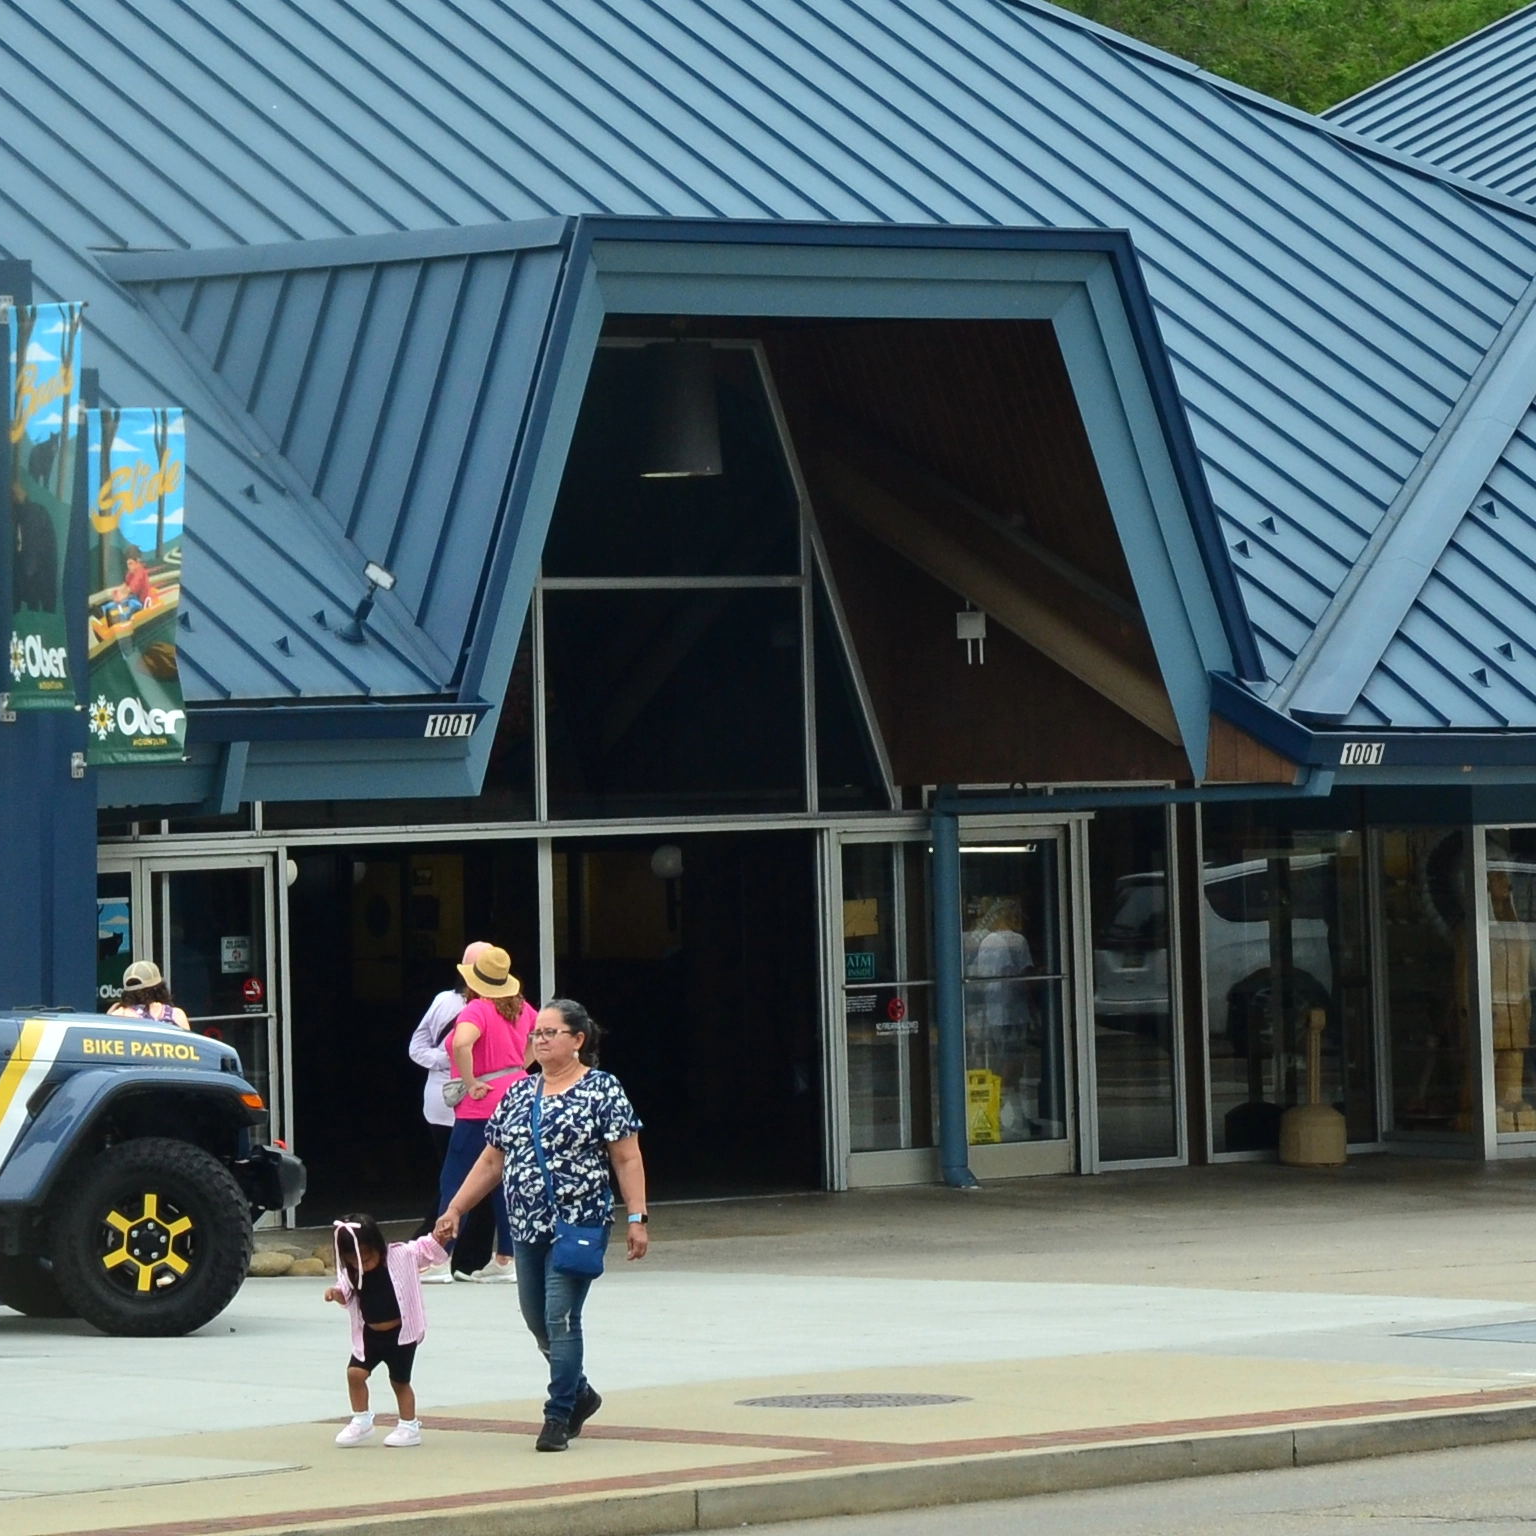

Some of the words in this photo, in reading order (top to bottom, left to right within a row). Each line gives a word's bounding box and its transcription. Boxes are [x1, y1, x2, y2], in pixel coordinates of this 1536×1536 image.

[91, 447, 182, 534] Slide
[430, 714, 474, 736] 1001
[1345, 743, 1383, 764] 1001
[847, 955, 872, 968] ATM
[99, 984, 124, 999] Obe
[83, 1038, 125, 1056] BIKE
[131, 1041, 201, 1062] PATROL
